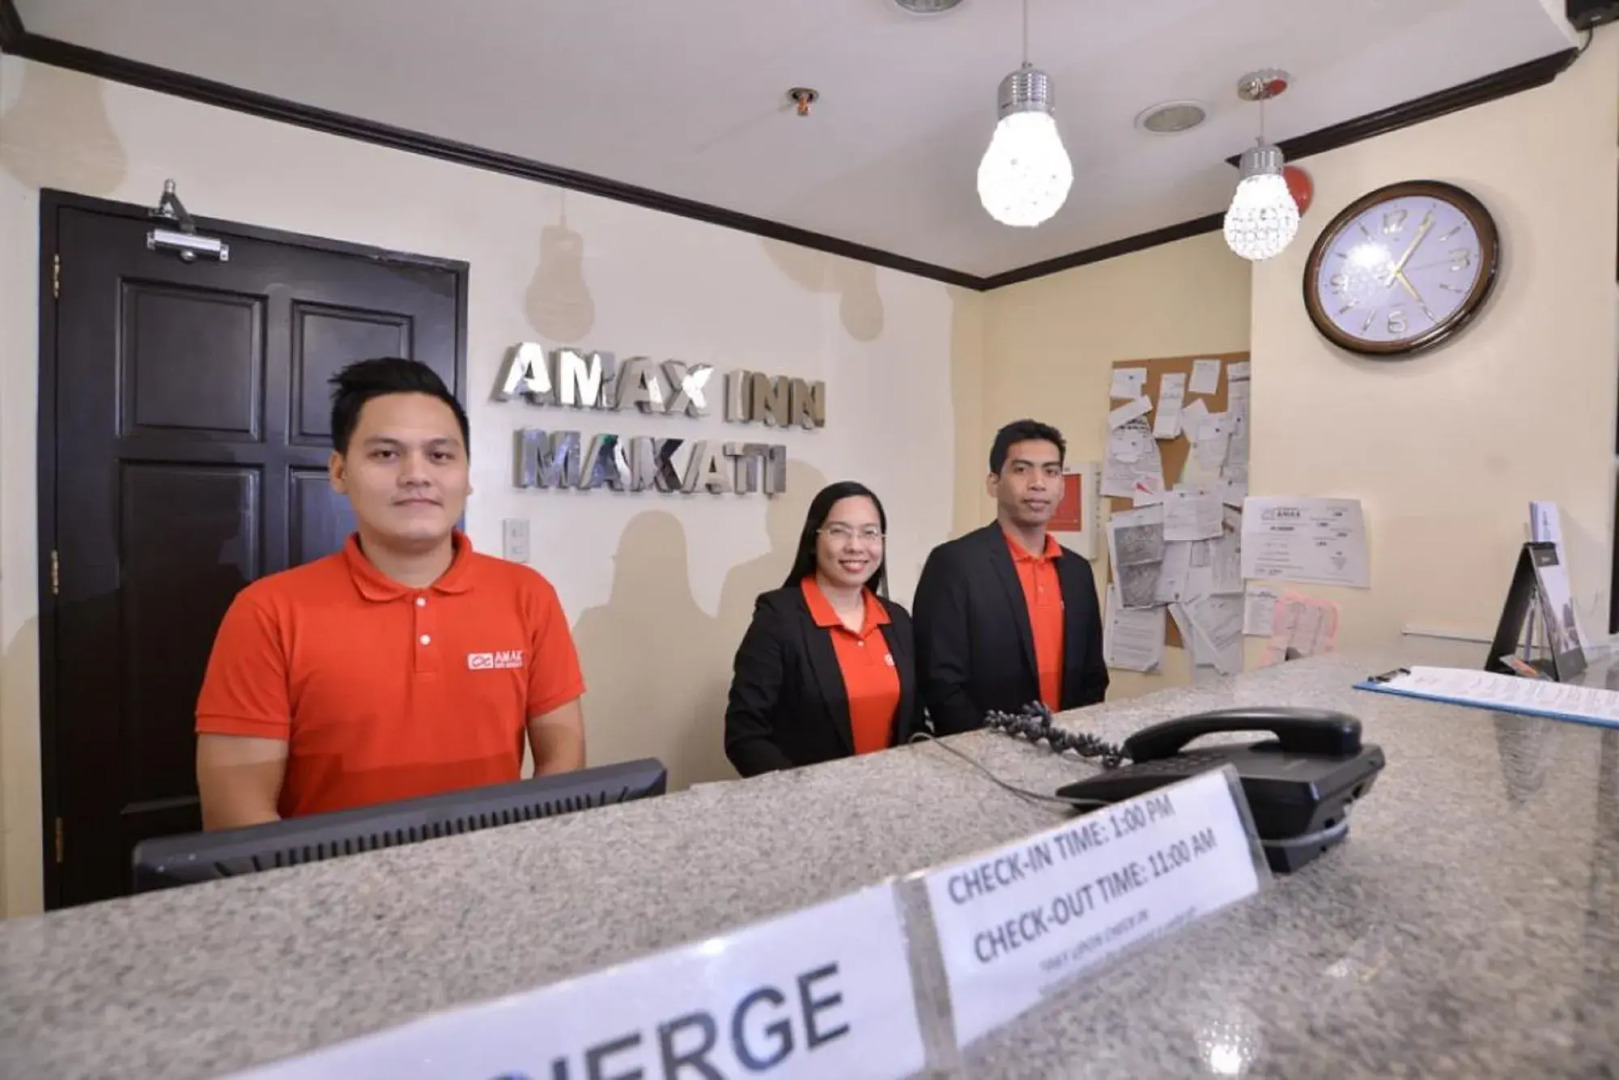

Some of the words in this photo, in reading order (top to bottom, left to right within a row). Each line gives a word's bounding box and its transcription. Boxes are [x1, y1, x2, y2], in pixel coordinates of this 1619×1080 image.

[489, 341, 715, 418] AMAX
[724, 369, 826, 429] INN
[512, 428, 787, 495] MAKATI
[946, 843, 1054, 905] CHECK-IN
[1053, 822, 1110, 861] TIME:
[1109, 801, 1146, 839] 1:00
[1145, 793, 1176, 824] PM
[972, 884, 1097, 964] CHECK-OUT
[1096, 860, 1150, 905] TIME:
[1187, 827, 1218, 860] AM
[486, 961, 852, 1080] ERGE
